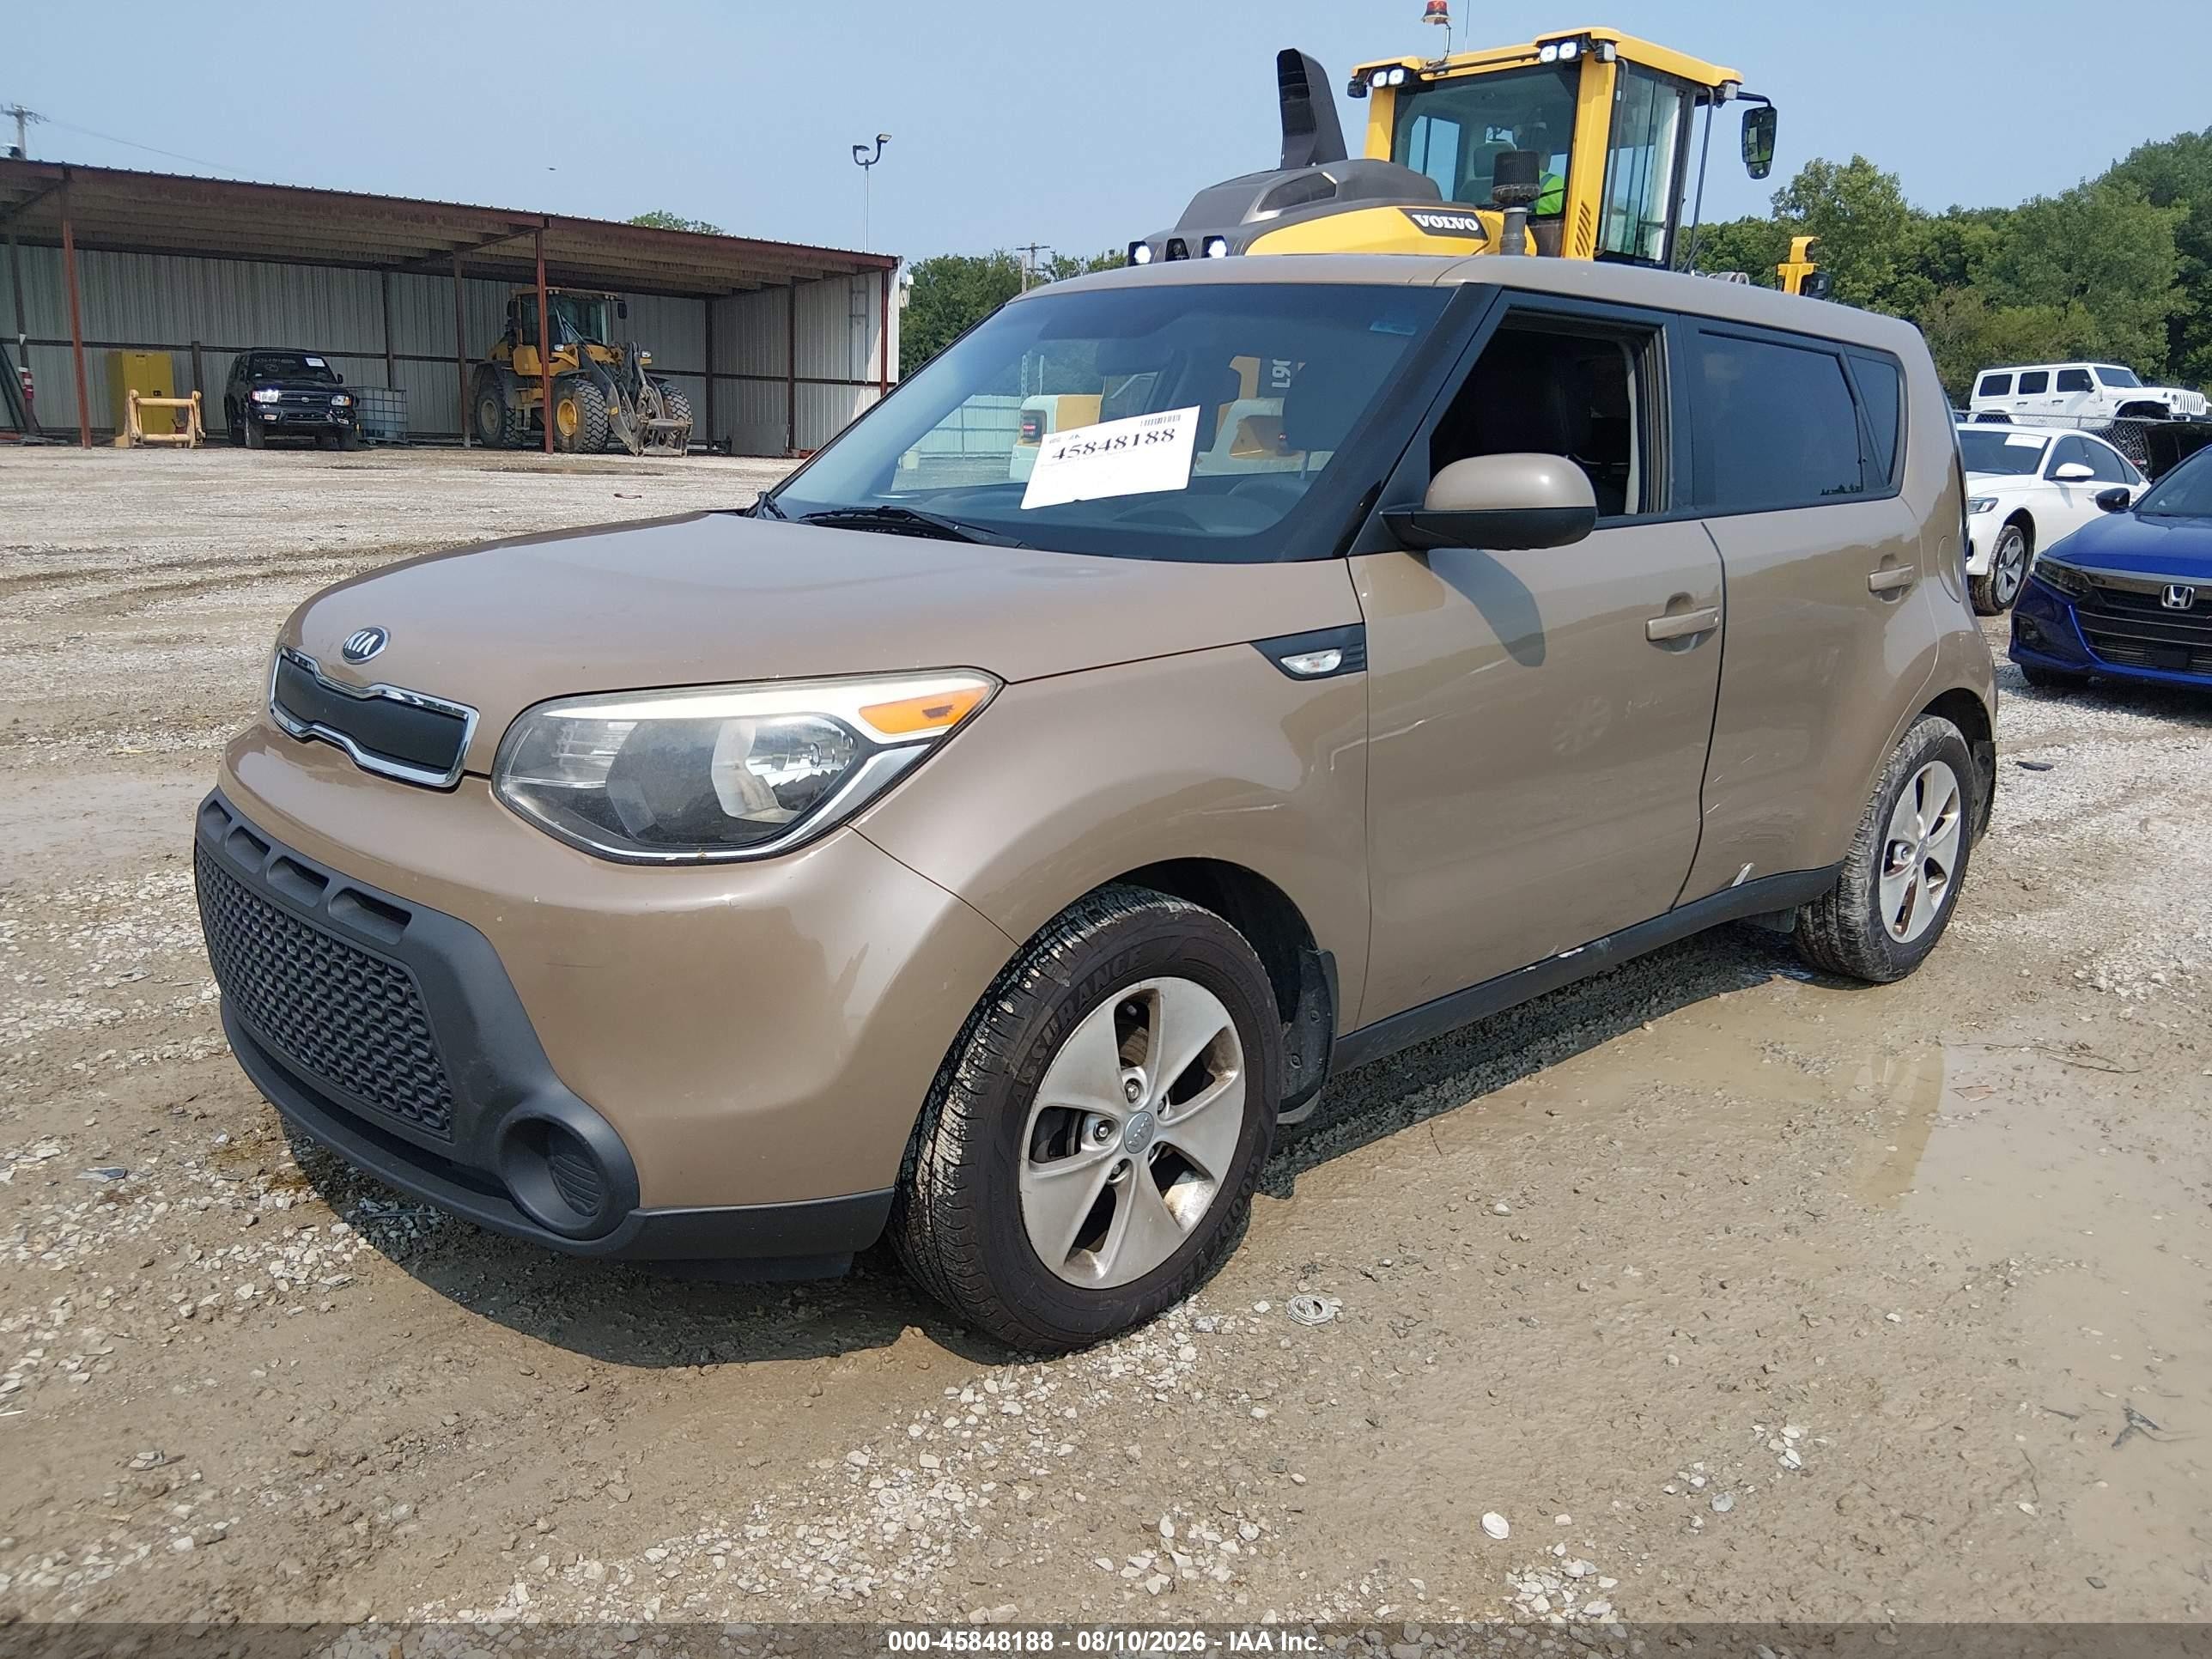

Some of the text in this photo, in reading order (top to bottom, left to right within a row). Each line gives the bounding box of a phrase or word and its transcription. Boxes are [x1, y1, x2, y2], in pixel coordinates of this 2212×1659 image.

[1411, 214, 1479, 232] VOLVO
[1051, 428, 1176, 460] 45848188
[1008, 946, 1142, 1108] ASSURANCE
